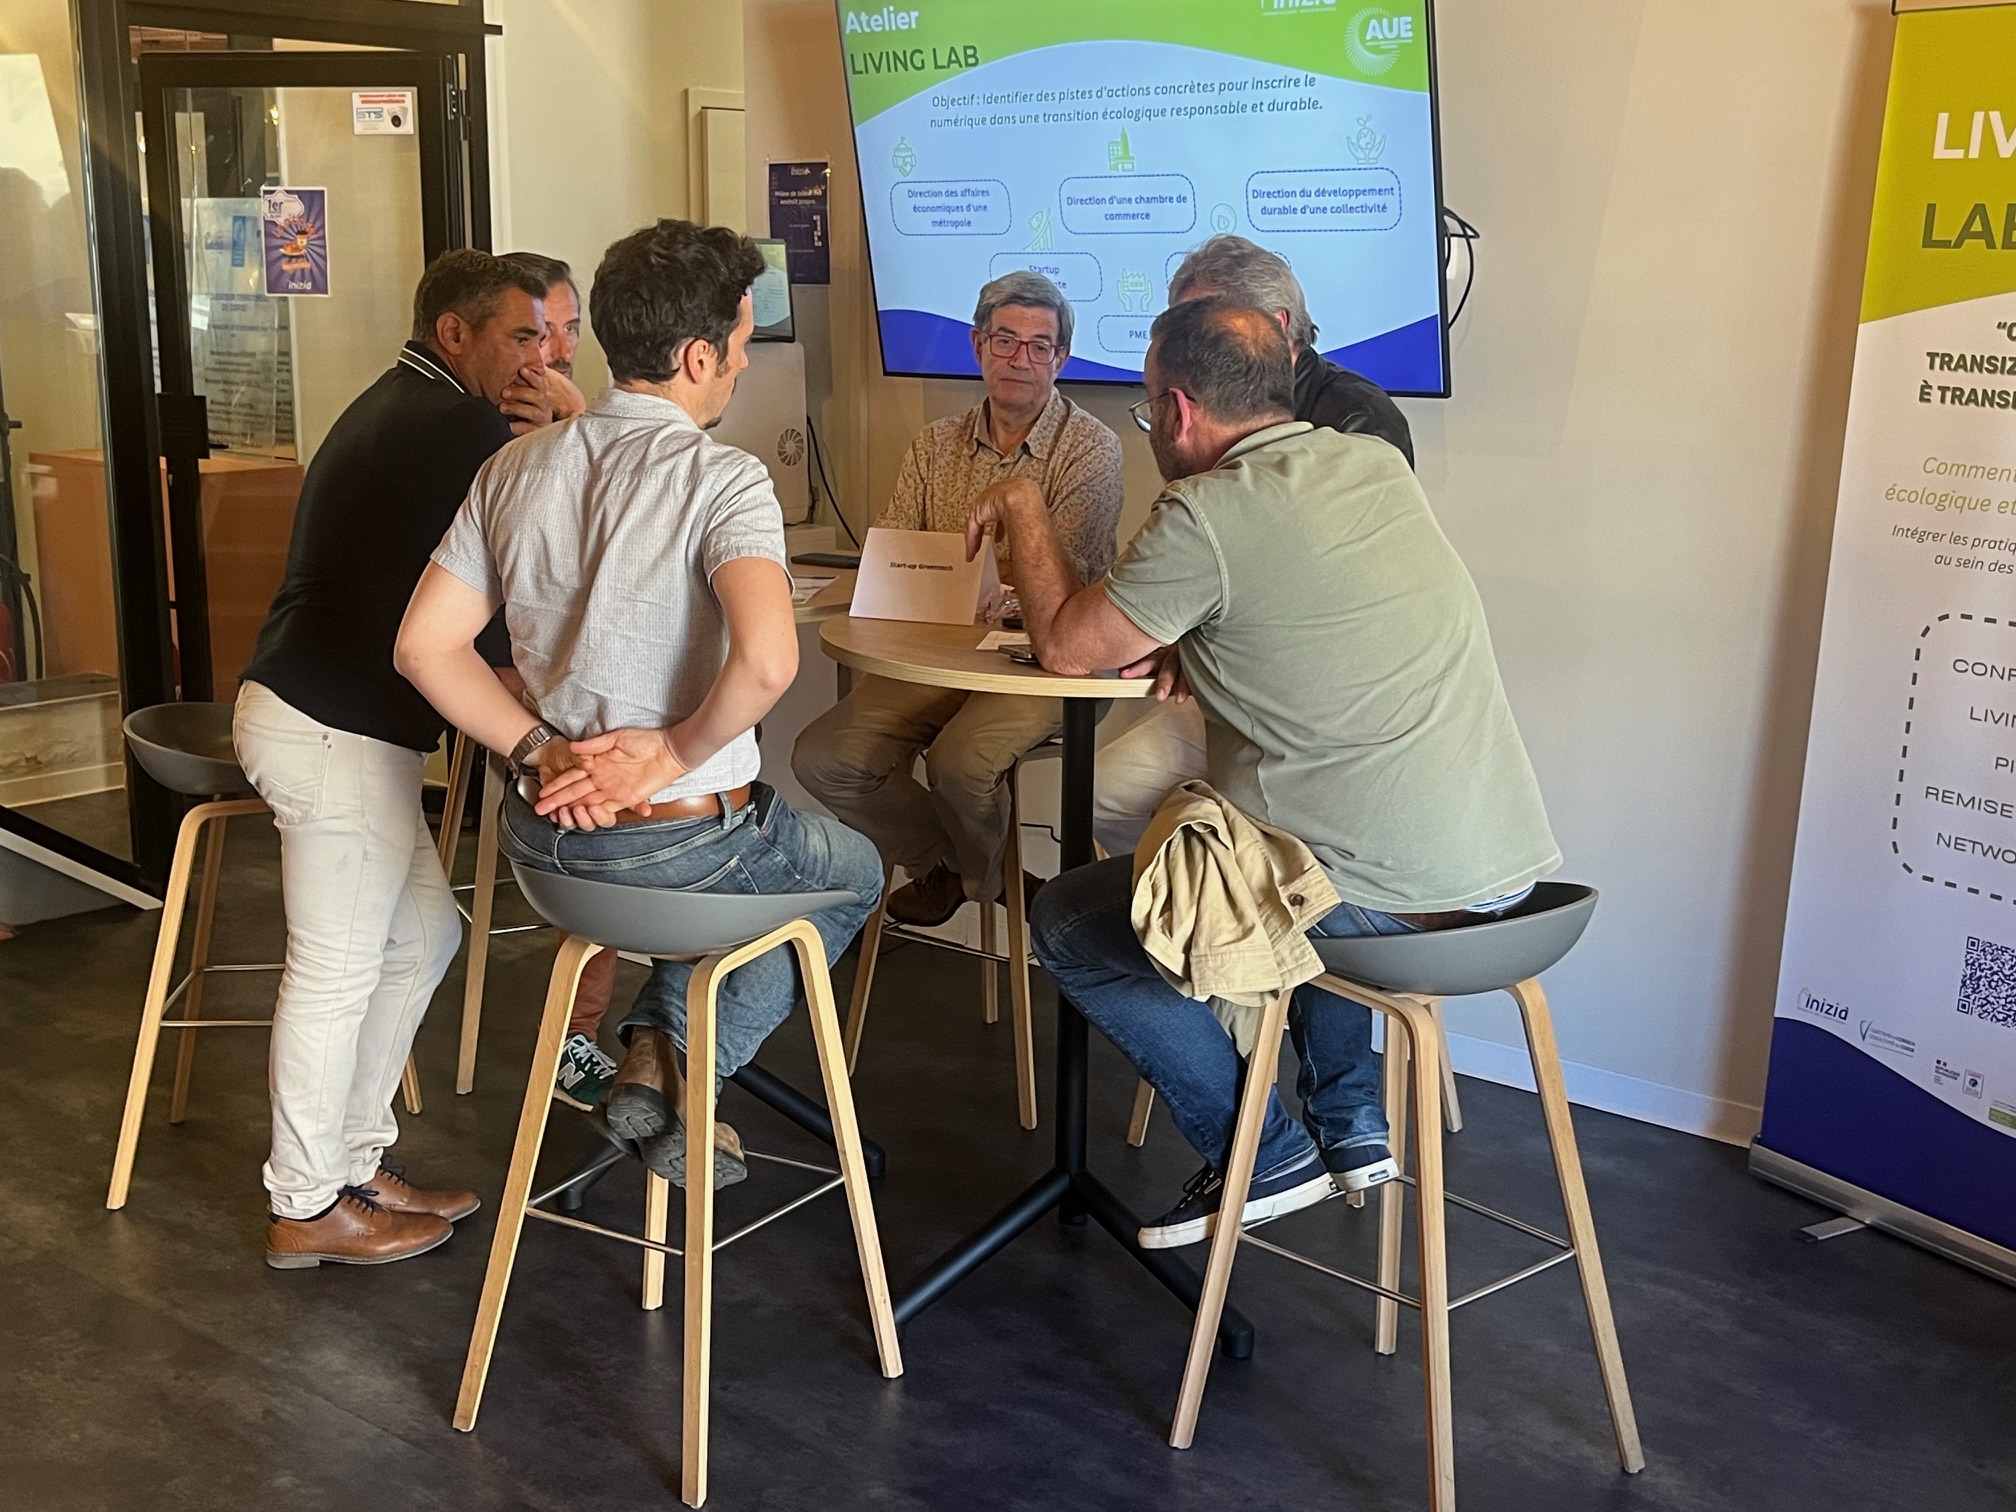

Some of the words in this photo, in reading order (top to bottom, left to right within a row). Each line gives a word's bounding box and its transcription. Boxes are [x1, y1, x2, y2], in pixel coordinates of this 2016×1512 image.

[846, 6, 918, 34] Atelier
[1366, 16, 1413, 40] AUE
[851, 49, 925, 75] LIVING
[932, 45, 980, 70] LAB
[932, 93, 974, 110] Objectif
[982, 91, 1033, 106] Identifier
[1036, 90, 1056, 102] des
[1059, 87, 1093, 104] pistes
[1154, 80, 1215, 97] concrètes
[1218, 79, 1248, 95] pour
[1251, 75, 1300, 90] inscrire
[1304, 74, 1316, 87] le
[930, 111, 986, 129] numérique
[990, 110, 1016, 125] dans
[1019, 112, 1040, 124] une
[1043, 108, 1098, 123] transition
[1102, 106, 1166, 122] écologique
[1170, 100, 1248, 120] responsable
[1251, 100, 1264, 114] et
[1267, 97, 1323, 112] durable.
[908, 189, 943, 198] Direction
[944, 189, 958, 198] des
[960, 188, 990, 198] affaires
[1066, 196, 1107, 206] Direction
[1134, 194, 1174, 204] chambre
[1176, 194, 1188, 204] de
[1252, 188, 1297, 199] Direction
[1299, 188, 1312, 198] du
[1314, 186, 1394, 200] développement
[268, 200, 284, 211] 1er
[912, 204, 964, 214] économiques
[1104, 212, 1150, 220] commerce
[1260, 204, 1298, 216] durable
[1330, 203, 1388, 214] collectivité
[932, 218, 972, 230] métropole
[1029, 265, 1060, 275] Startup
[1129, 330, 1148, 340] PME
[1919, 380, 1933, 404] È
[1886, 483, 1991, 514] écologique
[1892, 524, 1947, 544] Intégrer
[1949, 531, 1968, 546] les
[1934, 554, 1952, 566] au
[1955, 556, 1984, 570] sein
[1988, 560, 2014, 574] des
[1925, 786, 2014, 819] REMISE
[1936, 832, 2016, 864] NETWO
[558, 1061, 585, 1090] N
